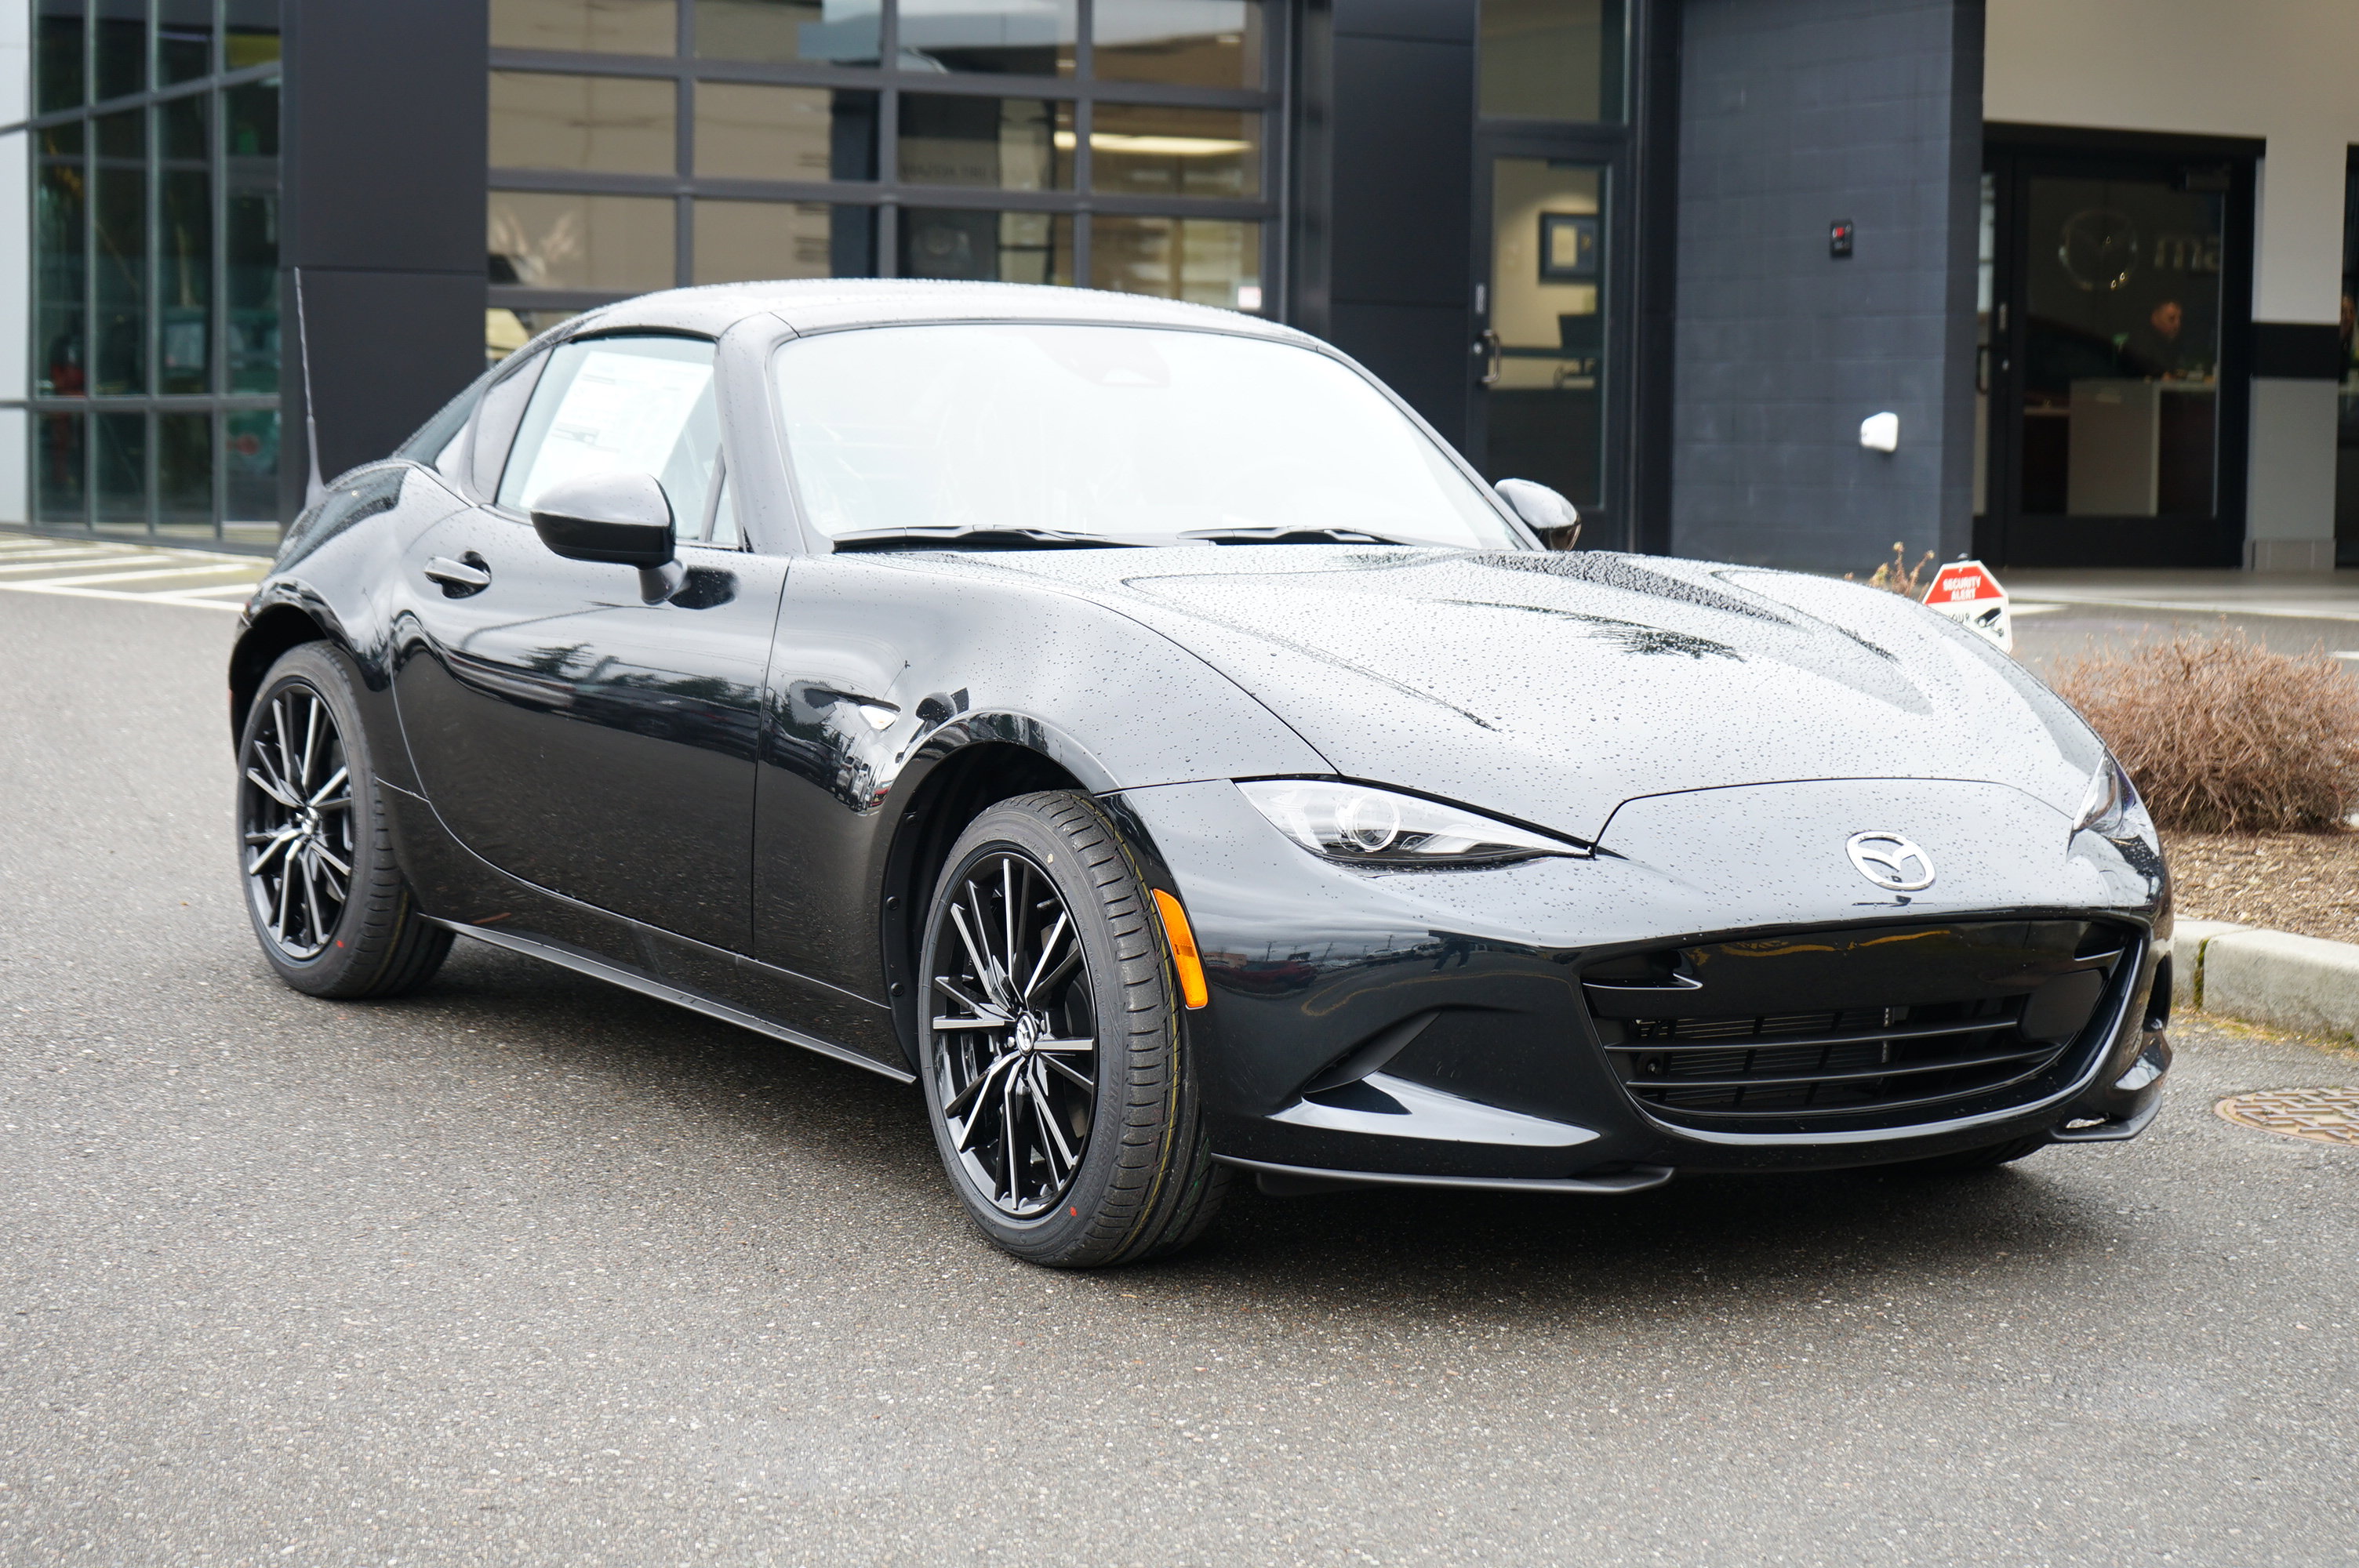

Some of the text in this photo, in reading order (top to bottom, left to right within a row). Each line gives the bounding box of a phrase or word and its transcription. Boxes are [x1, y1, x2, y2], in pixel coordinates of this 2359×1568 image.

[1943, 575, 1981, 591] SECURITY
[1950, 588, 1976, 601] ALERT
[1949, 612, 1970, 623] OUR
